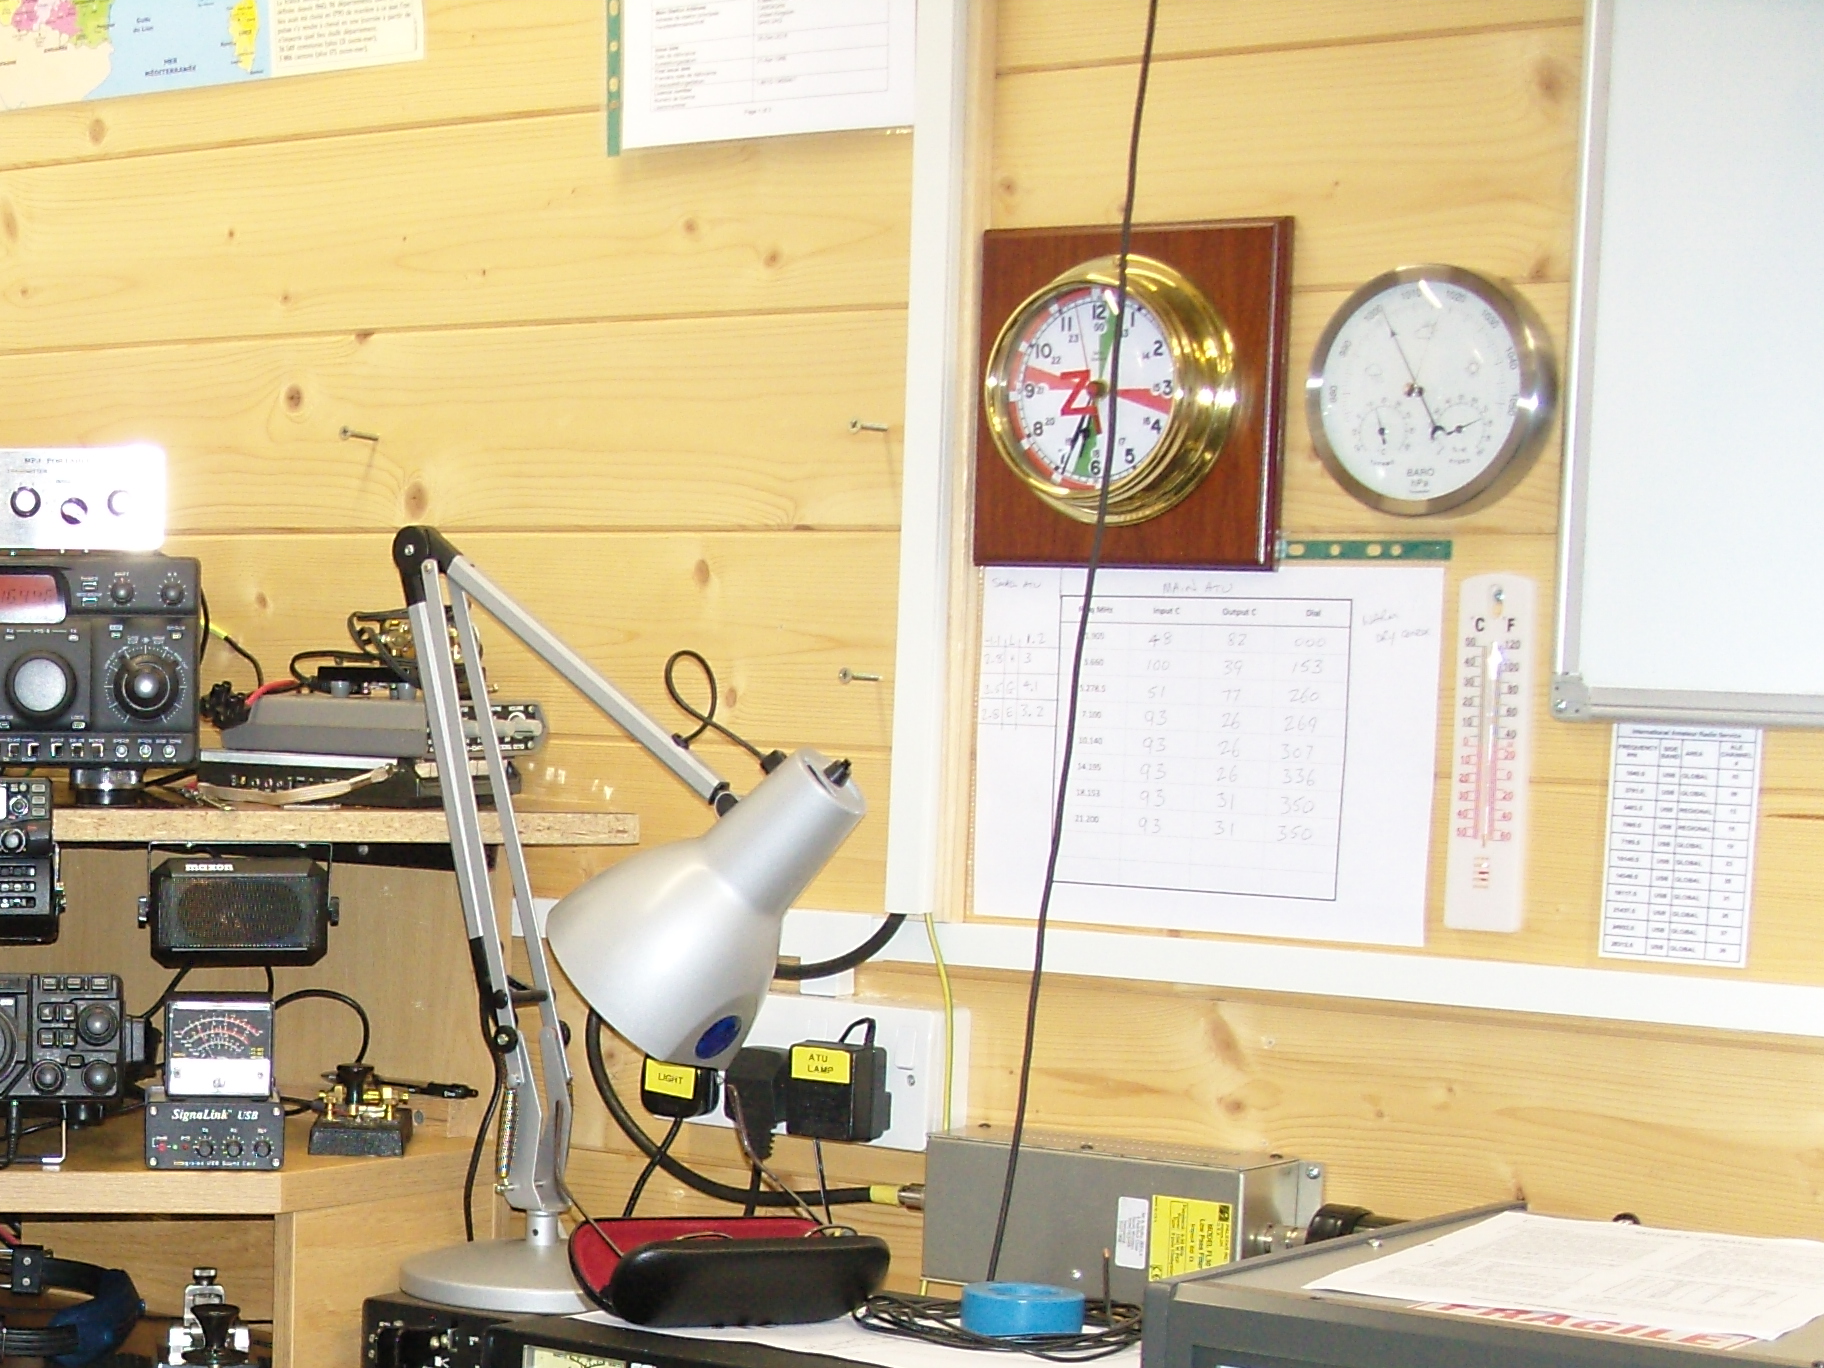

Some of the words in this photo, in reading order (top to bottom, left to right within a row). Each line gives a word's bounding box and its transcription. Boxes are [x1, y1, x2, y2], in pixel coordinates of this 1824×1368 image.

[1092, 304, 1106, 320] 12
[1060, 316, 1072, 332] 11
[1034, 342, 1053, 359] 10
[1153, 340, 1164, 356] 2
[1025, 383, 1035, 399] 9
[1162, 379, 1173, 396] 3
[1033, 421, 1044, 436] 8
[1150, 418, 1162, 433] 4
[1124, 448, 1135, 464] 5
[1090, 460, 1101, 475] 6
[1406, 468, 1435, 477] BARO
[1410, 479, 1429, 488] hPa
[1162, 581, 1197, 594] MAIN
[1205, 581, 1233, 594] ATU
[1222, 607, 1248, 617] Output
[1306, 608, 1321, 617] Dial
[1146, 658, 1170, 672] 100
[1222, 659, 1244, 677] 39
[1290, 660, 1323, 675] 153
[1143, 709, 1169, 726] 93
[1220, 711, 1241, 730] 26
[1283, 714, 1317, 733] 269
[1141, 736, 1167, 753] 93
[1216, 738, 1241, 758] 26
[1280, 742, 1314, 760] 307
[1139, 761, 1168, 781] 93
[1215, 764, 1239, 783] 26
[1281, 768, 1316, 787] 336
[1139, 788, 1166, 808] 93
[1216, 791, 1234, 811] 31
[1280, 795, 1315, 815] 350
[1137, 816, 1162, 835] 93
[1214, 818, 1234, 837] 31
[1277, 823, 1313, 841] 350
[185, 863, 234, 872] maxon
[808, 1053, 828, 1063] ATU
[807, 1064, 834, 1074] LAMP
[657, 1072, 683, 1085] LIGHT
[237, 1111, 259, 1120] USB
